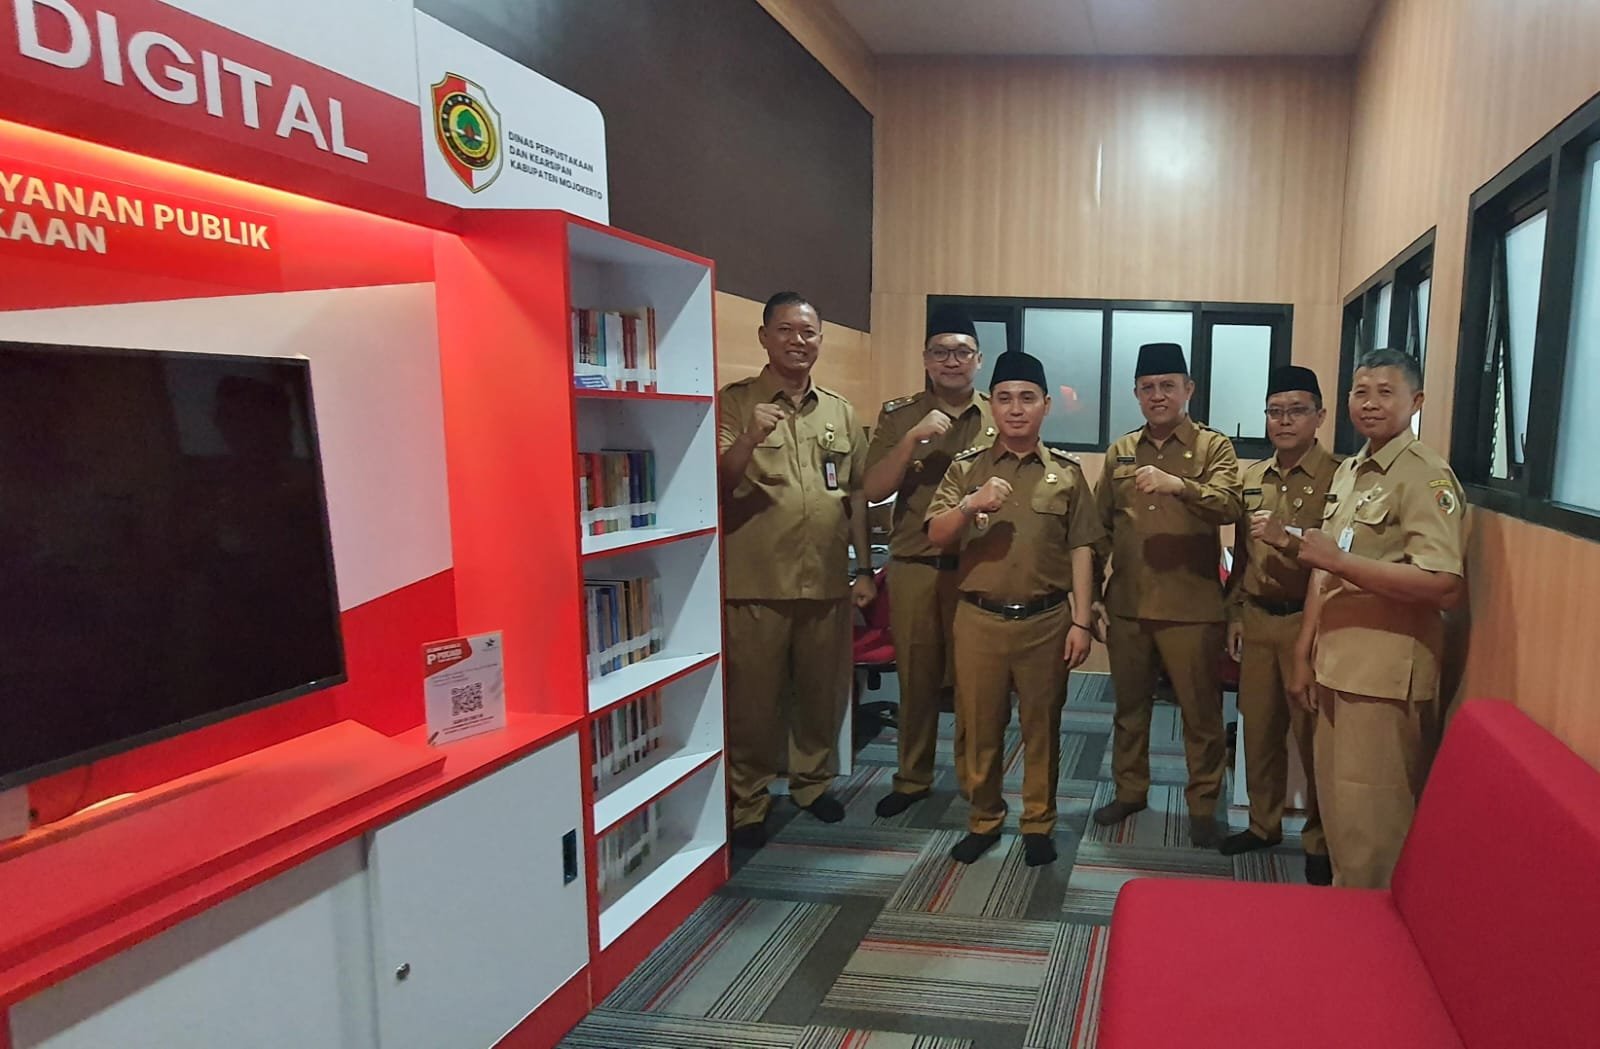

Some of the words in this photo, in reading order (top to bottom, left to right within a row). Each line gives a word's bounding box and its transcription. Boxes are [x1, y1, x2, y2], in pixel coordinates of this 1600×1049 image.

[14, 0, 369, 164] DIGITAL
[508, 130, 534, 149] DINAS
[535, 142, 594, 173] PERPUSTAKAAN
[509, 145, 528, 160] DAN
[529, 152, 572, 176] KEARSIPAN
[510, 159, 558, 184] KABUPATEN
[559, 177, 603, 200] MOJOKERTO
[153, 202, 271, 251] PUBLIK
